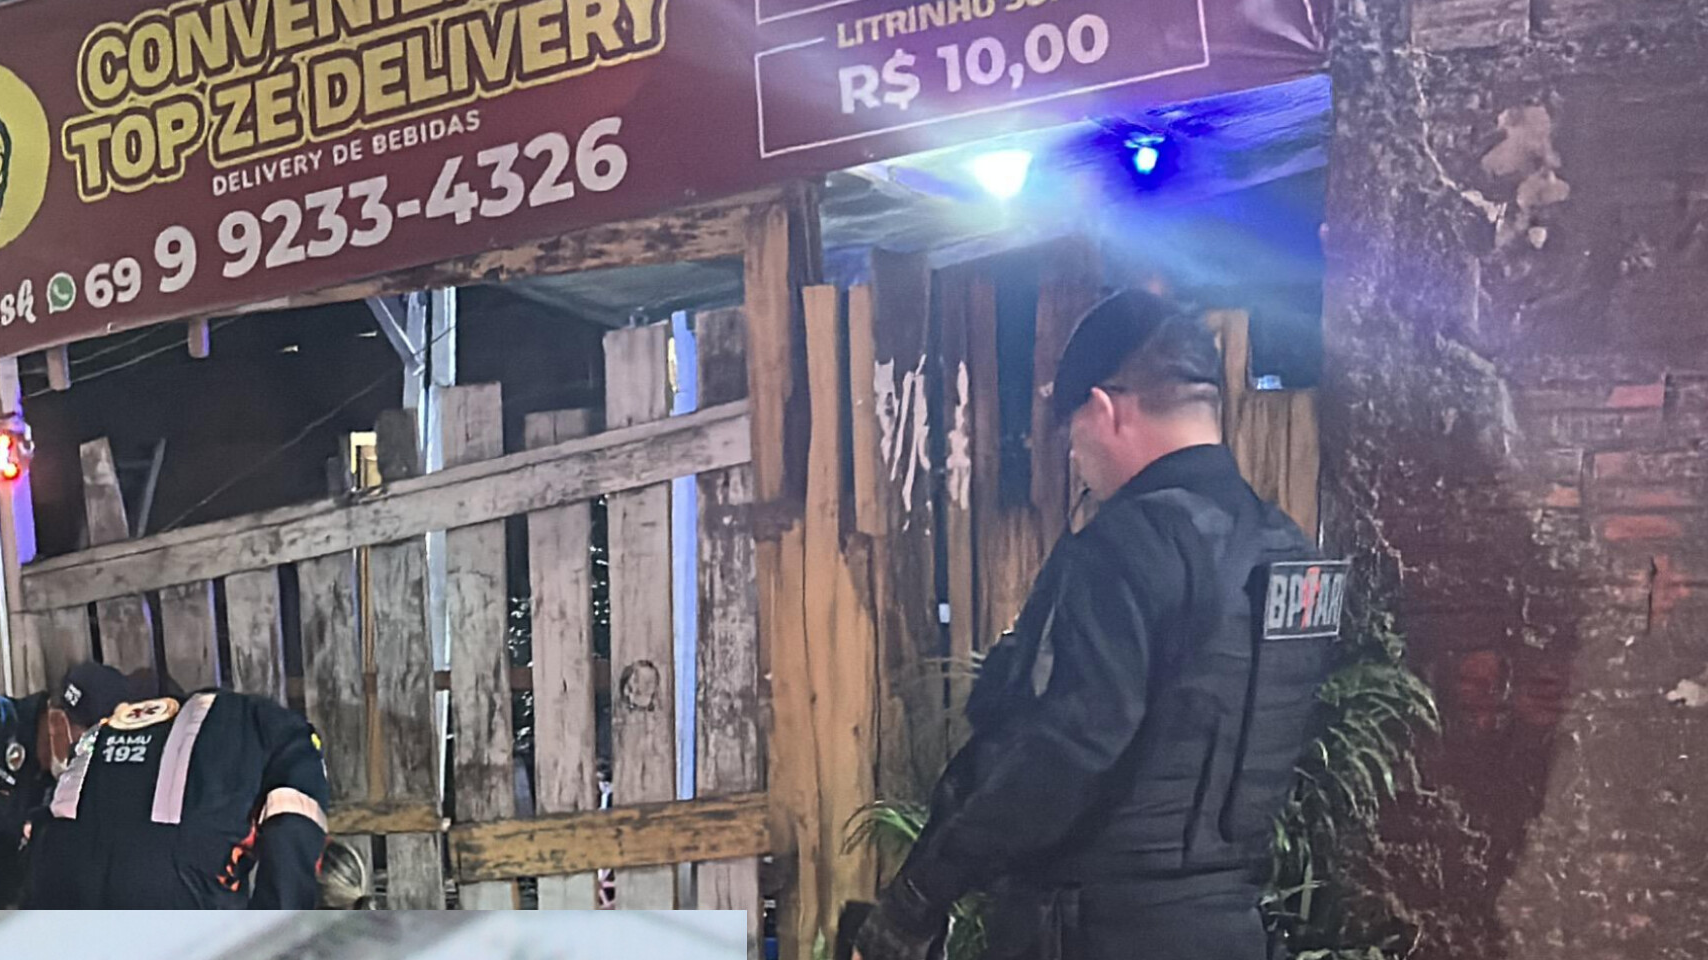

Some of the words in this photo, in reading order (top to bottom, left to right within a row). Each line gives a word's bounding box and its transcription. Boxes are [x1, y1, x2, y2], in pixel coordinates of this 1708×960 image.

[837, 0, 996, 48] LITRINHO
[838, 48, 921, 114] R$
[936, 14, 1109, 92] 10,00
[71, 101, 200, 189] TOP
[215, 56, 298, 155] ZÉ
[312, 0, 654, 128] DELIVERY
[212, 149, 322, 196] DELIVERY
[333, 141, 363, 166] DE
[372, 110, 481, 156] BEBIDAS
[84, 257, 142, 308] 69
[154, 225, 197, 292] 9
[218, 117, 628, 278] 9233-4326
[102, 746, 147, 763] 192
